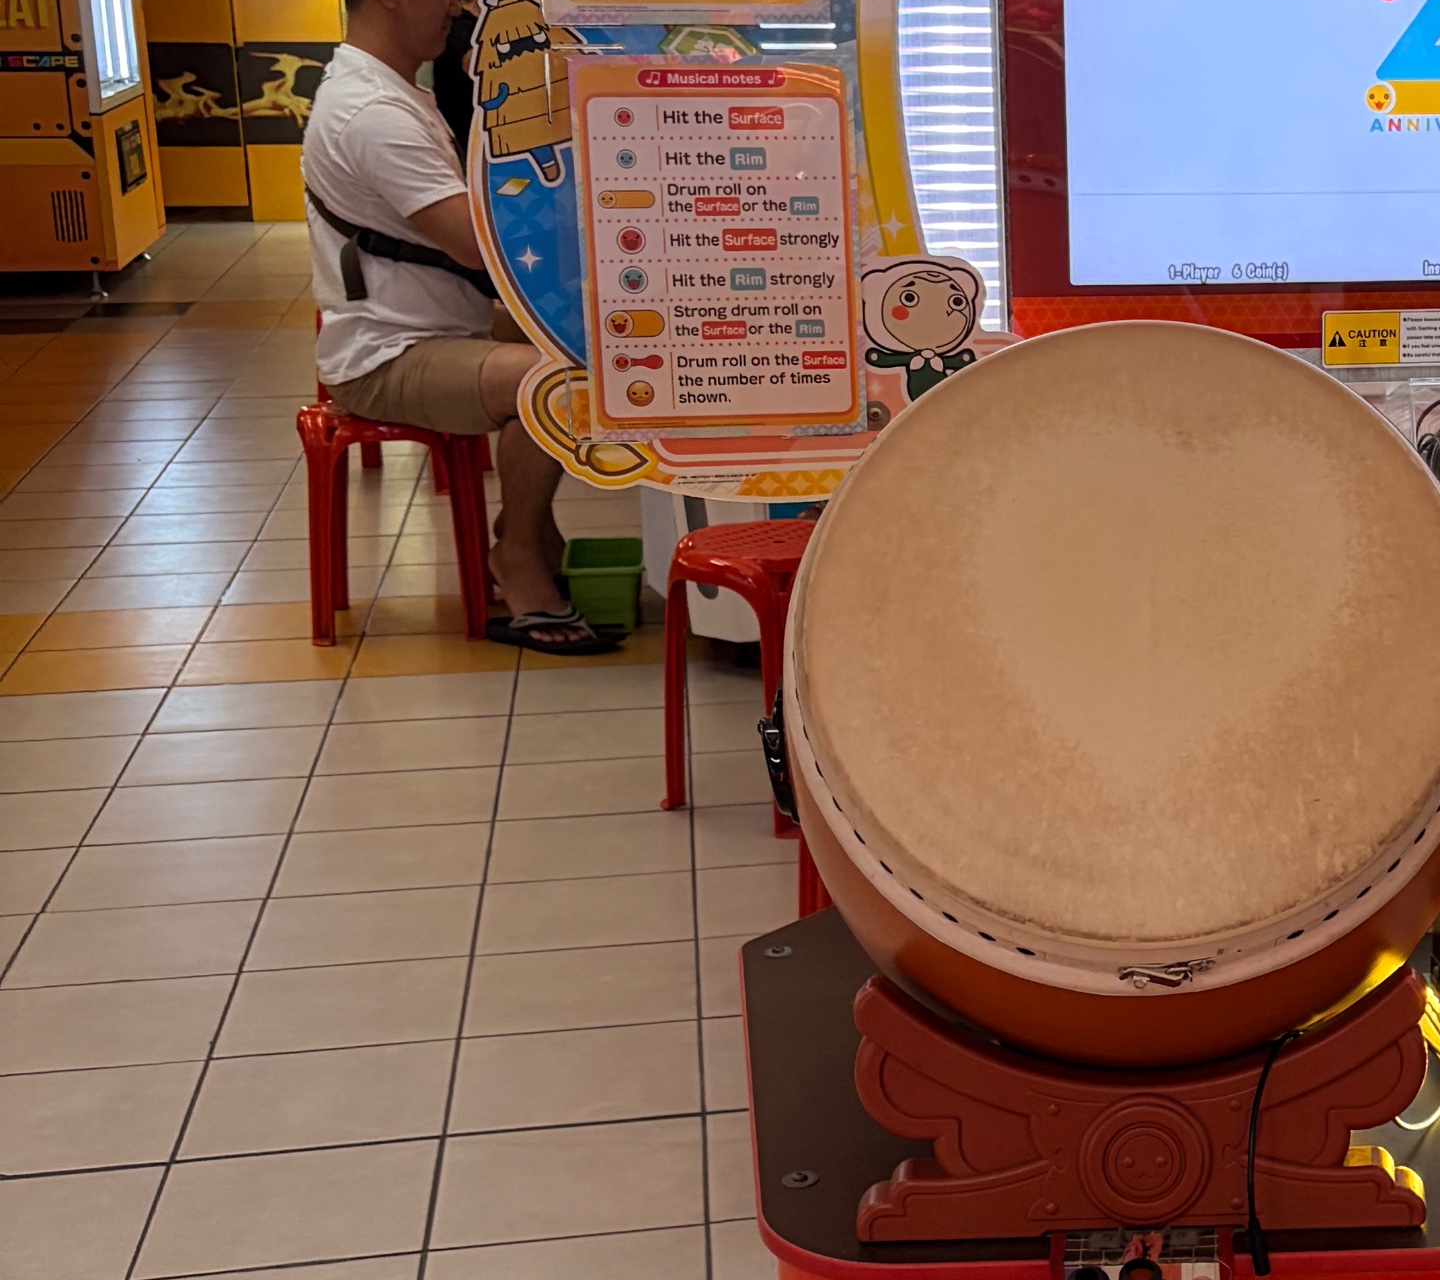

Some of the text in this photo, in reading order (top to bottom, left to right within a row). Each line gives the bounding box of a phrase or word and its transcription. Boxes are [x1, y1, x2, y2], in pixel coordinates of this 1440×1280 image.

[667, 73, 761, 85] Musical notes
[663, 111, 782, 125] Hit the Surface
[665, 152, 763, 166] Hit the Rim
[667, 183, 767, 196] Drum roll on
[669, 200, 817, 213] the Surface or the Rim
[670, 232, 839, 249] Hit the Surface strongly
[672, 272, 835, 289] Hit the Rim strongly
[1169, 263, 1288, 284] 1-Player 6 Coin(s)
[674, 303, 822, 320] Strong drum roll on
[676, 323, 822, 337] the Surface or the Rim
[1348, 329, 1396, 339] CAUTION
[678, 354, 845, 368] Drum roll on the Surface
[679, 371, 831, 387] the number of times
[679, 391, 731, 404] shown.
